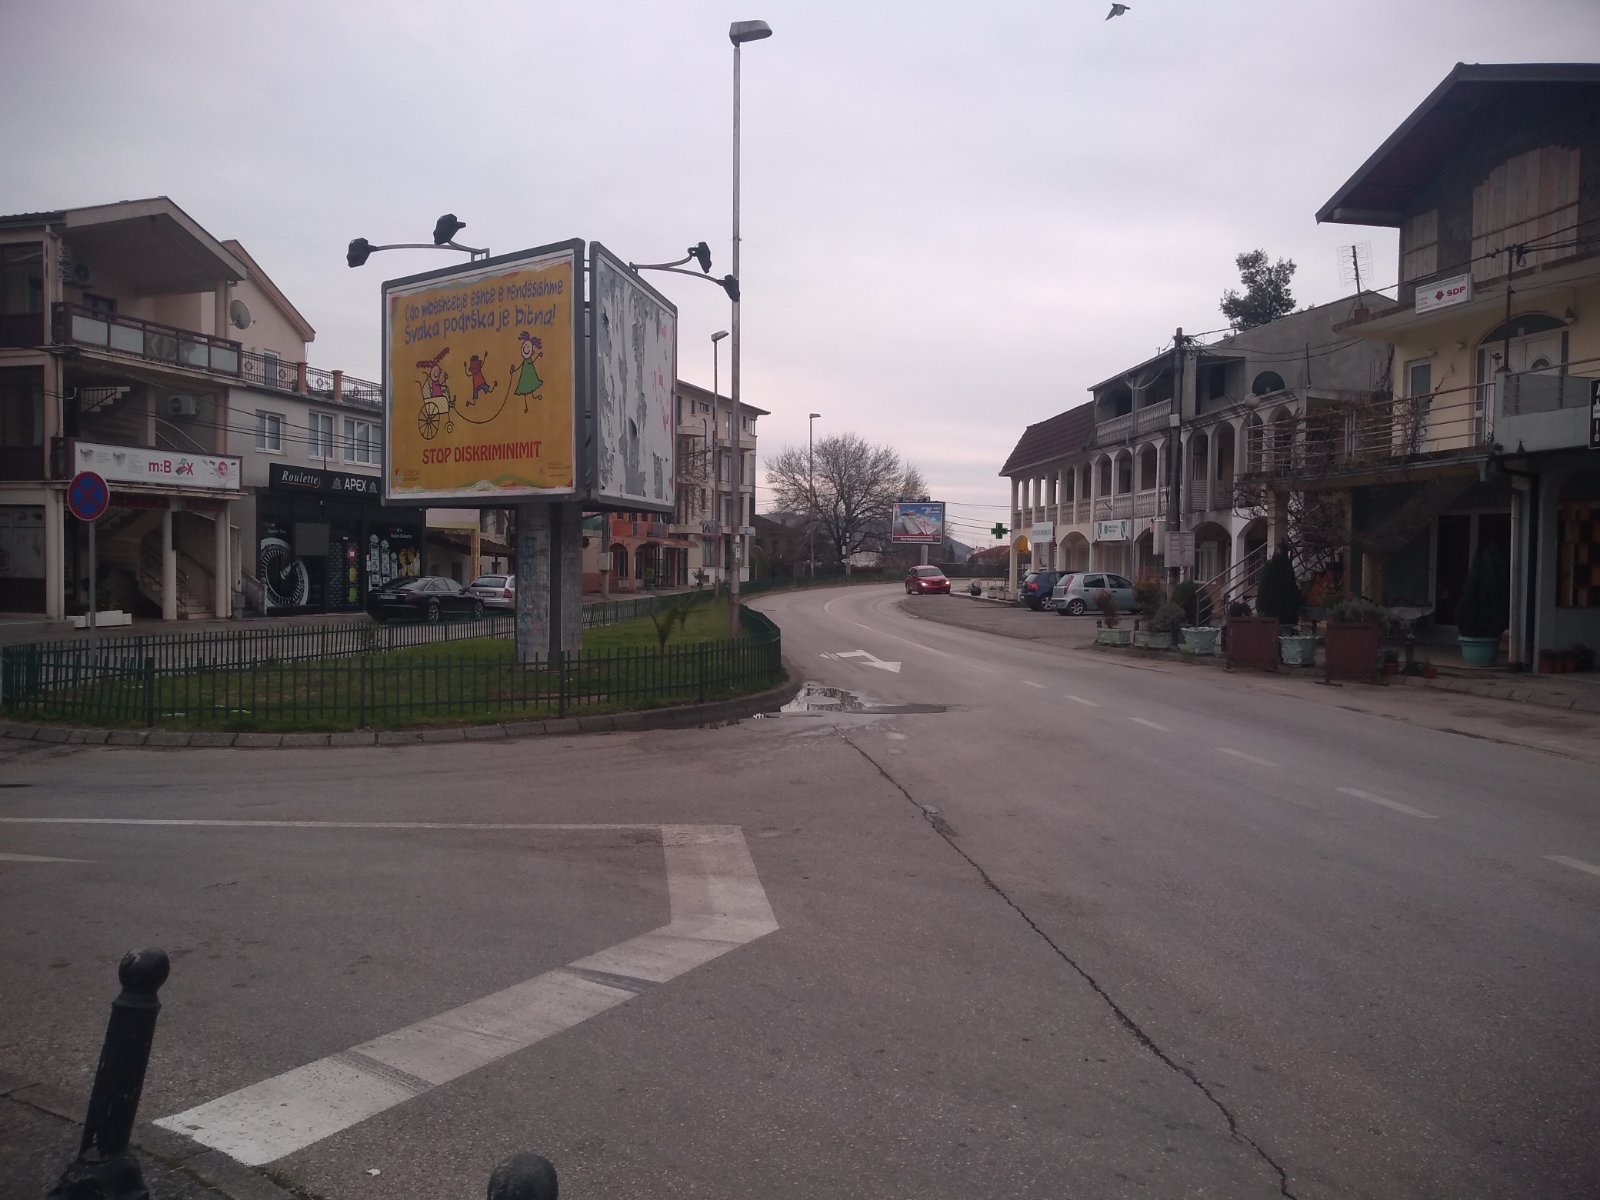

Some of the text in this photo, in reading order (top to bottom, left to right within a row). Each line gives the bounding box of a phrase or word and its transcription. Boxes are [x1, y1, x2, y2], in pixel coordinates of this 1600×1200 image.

[1446, 285, 1466, 297] SDP
[404, 303, 557, 345] Svaka podrška je bitna!
[422, 441, 542, 464] STOP DISKRIMINIMIT
[282, 471, 319, 485] Roulette
[344, 478, 367, 492] APEX
